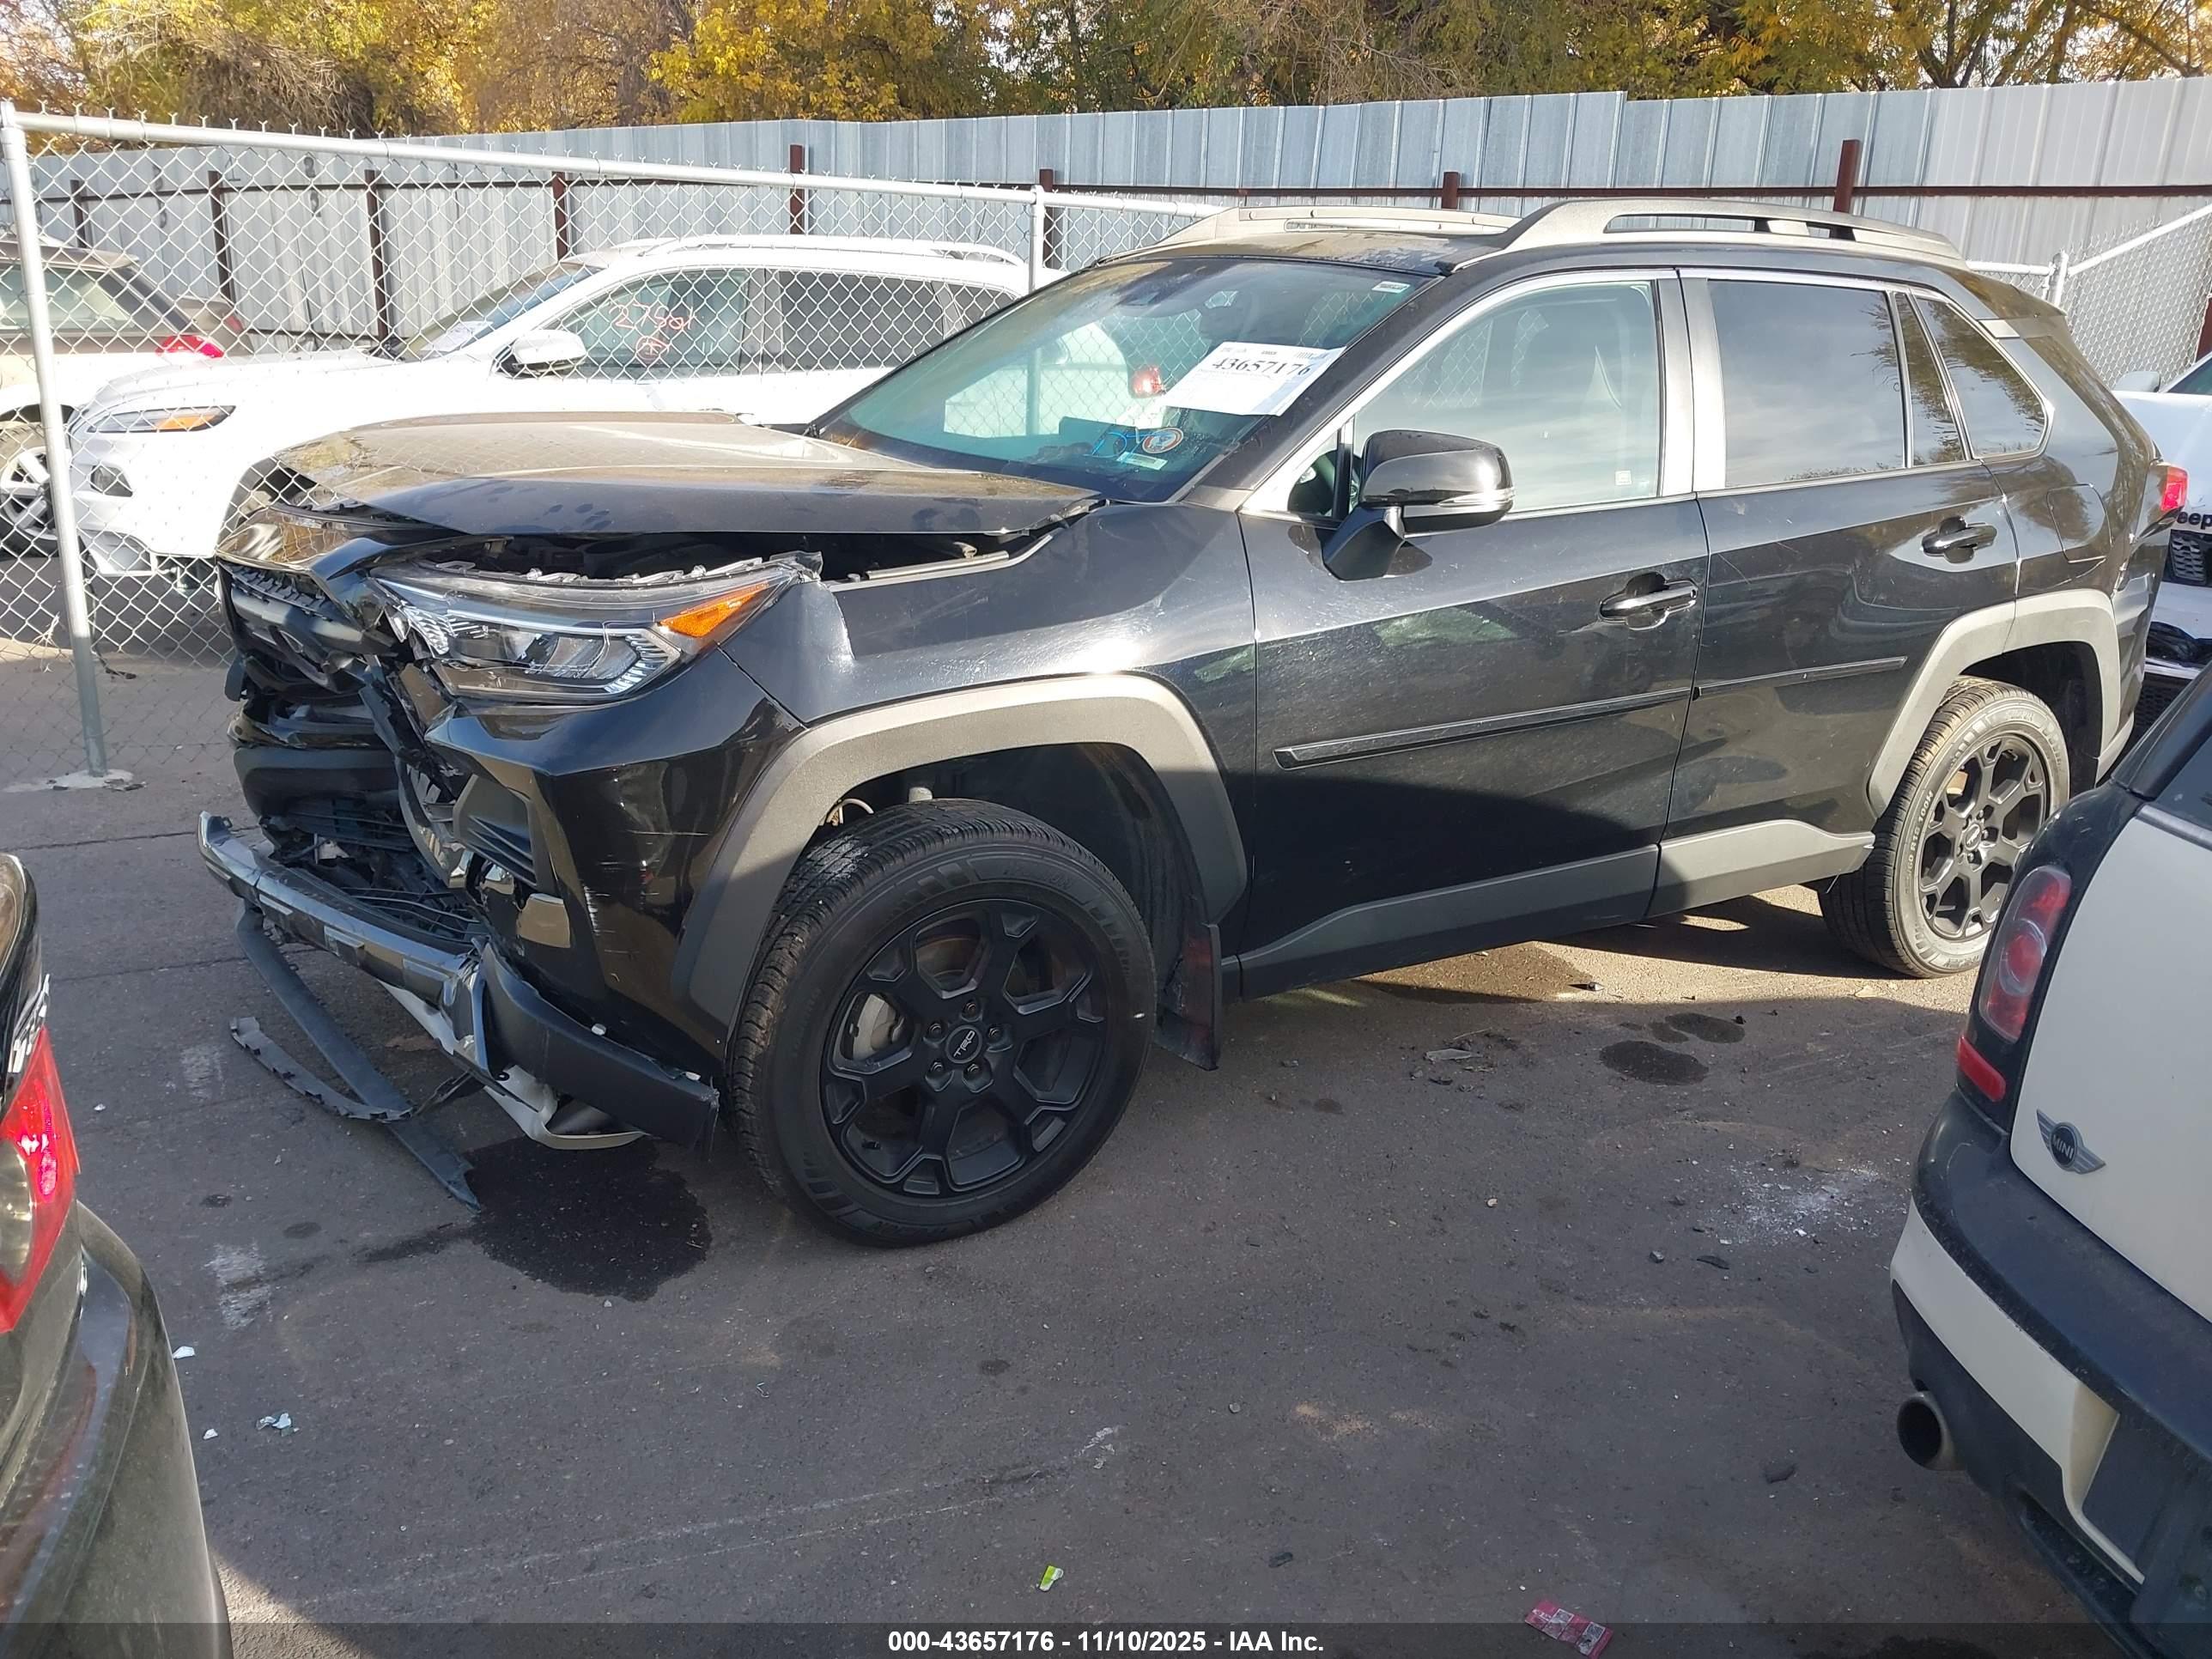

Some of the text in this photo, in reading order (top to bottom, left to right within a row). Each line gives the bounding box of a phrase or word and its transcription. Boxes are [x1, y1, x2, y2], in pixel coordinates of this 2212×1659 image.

[1212, 357, 1314, 376] 43657176
[2176, 511, 2212, 530] eep
[953, 1030, 975, 1057] TRD
[2052, 1133, 2075, 1159] MINI
